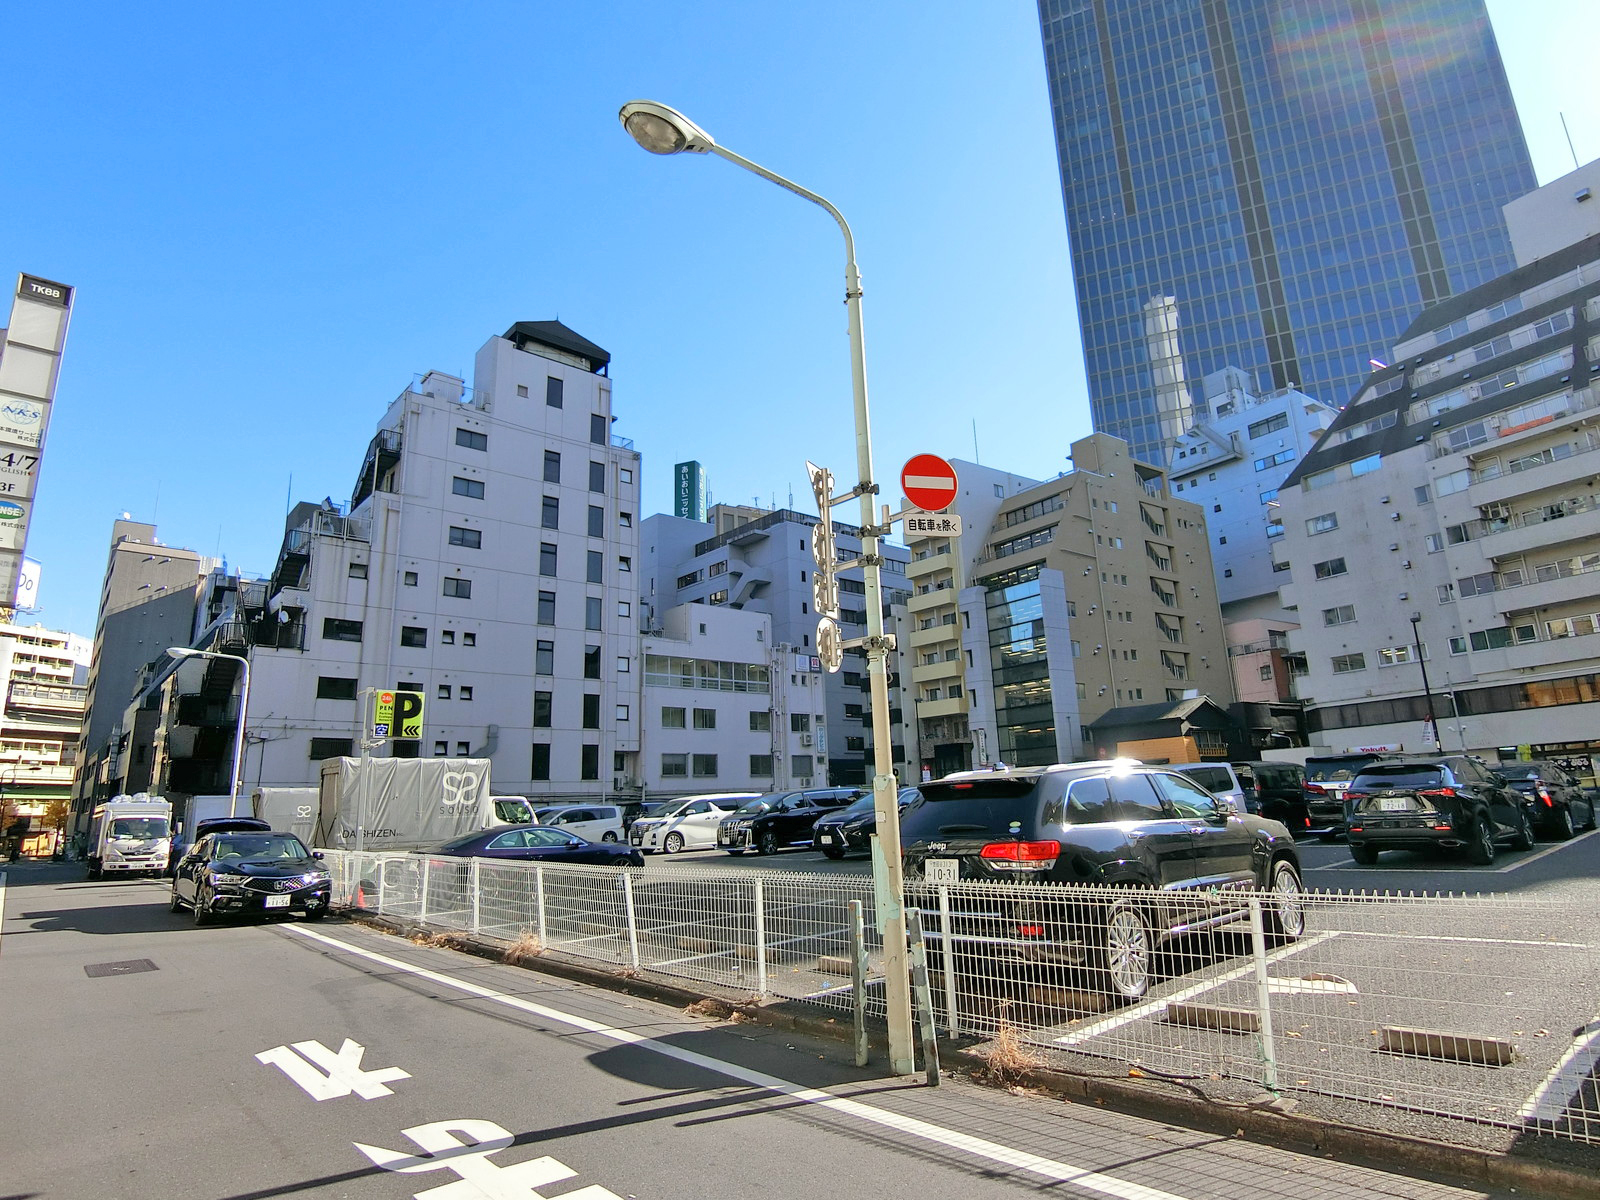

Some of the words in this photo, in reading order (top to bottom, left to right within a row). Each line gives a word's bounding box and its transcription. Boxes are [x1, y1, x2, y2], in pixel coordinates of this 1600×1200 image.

[0, 453, 38, 469] 4/7
[0, 466, 27, 476] GLISH
[909, 519, 957, 531] 自転車を除く
[392, 693, 422, 737] P
[342, 829, 397, 839] DASHIZEN
[927, 841, 947, 851] Jeep
